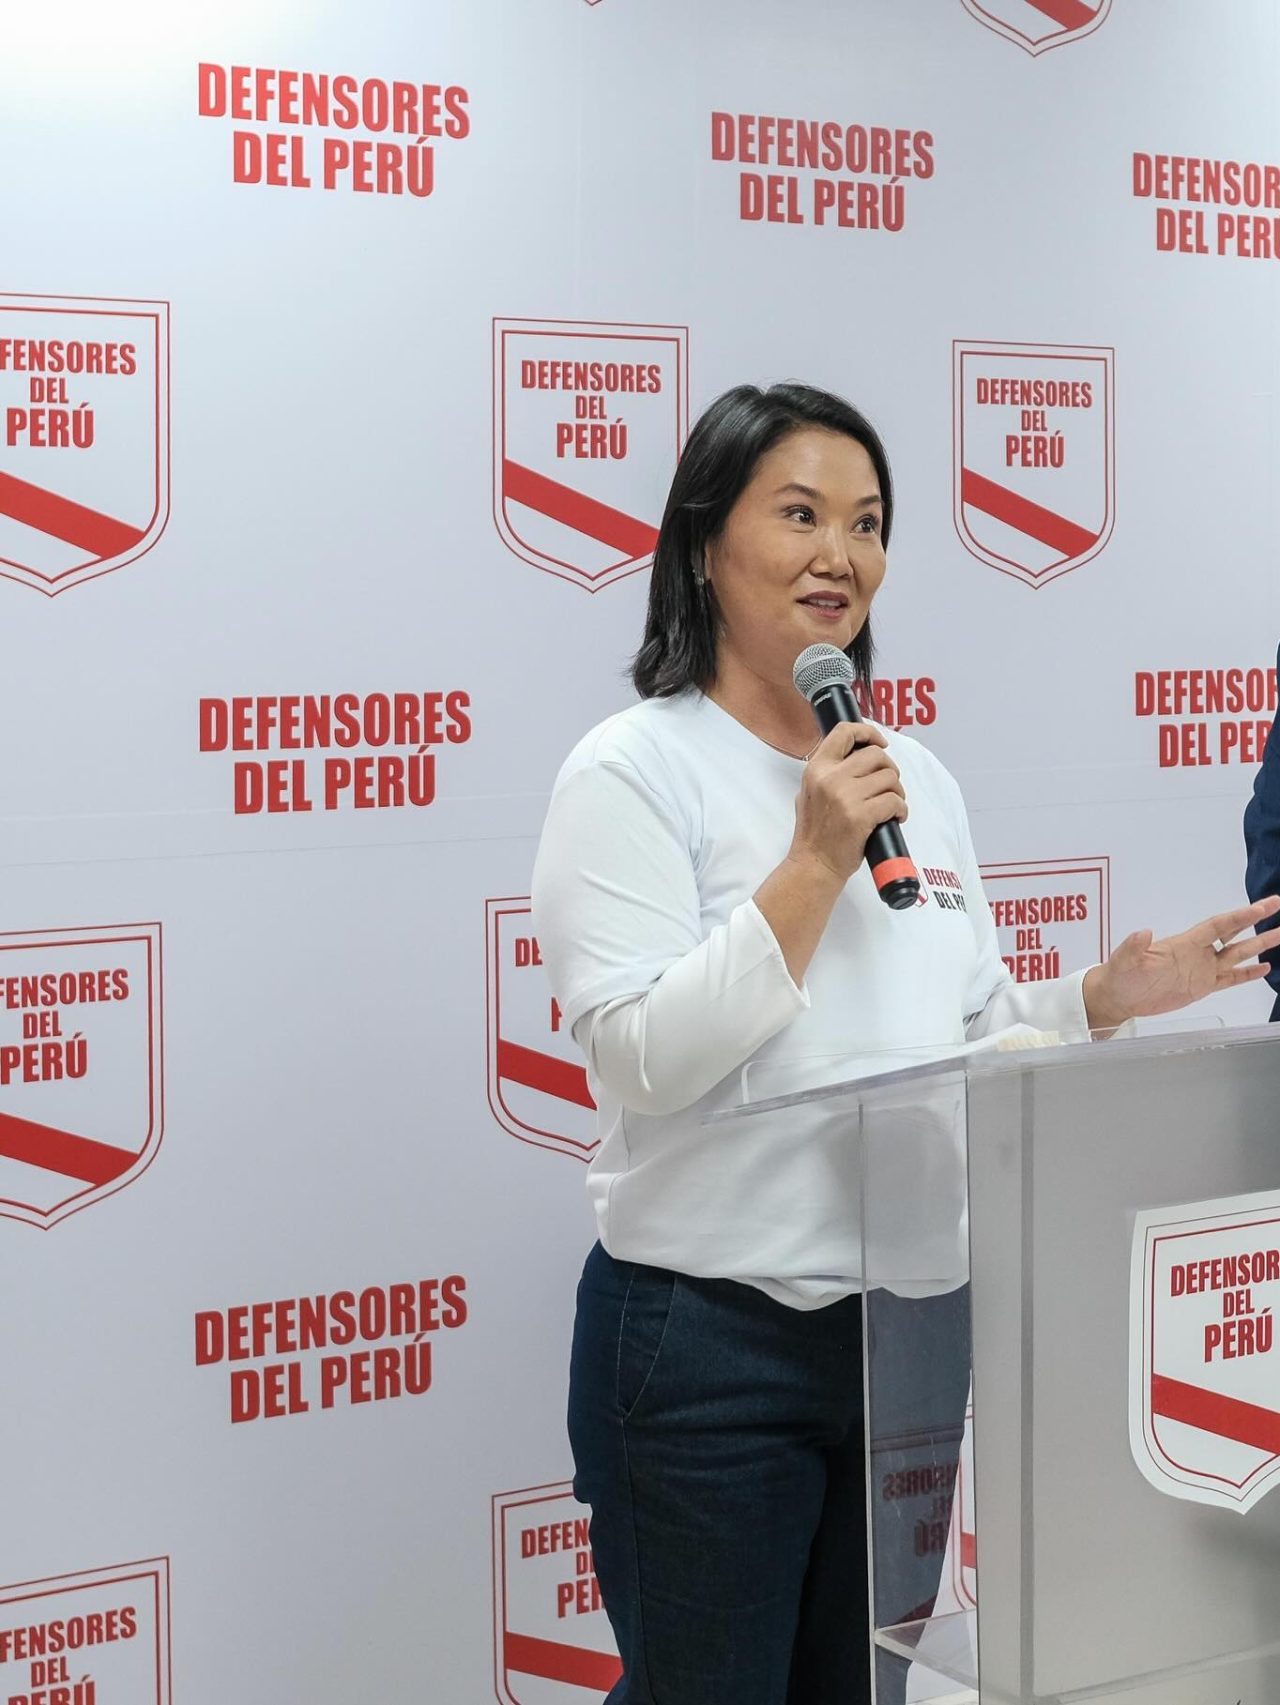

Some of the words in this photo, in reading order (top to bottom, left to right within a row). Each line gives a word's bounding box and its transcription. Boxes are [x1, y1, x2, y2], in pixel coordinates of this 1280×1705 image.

[199, 63, 469, 140] DEFENSORES
[234, 131, 311, 188] DEL
[324, 135, 439, 197] PERÚ
[711, 112, 934, 183] DEFENSORES
[740, 172, 803, 224] DEL
[814, 176, 904, 232] PERÚ
[1156, 208, 1209, 254] DEL
[30, 376, 68, 404] DEL
[521, 360, 662, 393] DEFENSORES
[976, 378, 1093, 412] DEFENSORES
[7, 402, 94, 448] PERÚ
[576, 394, 606, 420] DEL
[1020, 408, 1047, 433] DEL
[556, 418, 628, 460] PERÚ
[1006, 434, 1065, 468] PERÚ
[200, 691, 471, 752] DEFENSORES
[1159, 723, 1212, 768] DEL
[235, 760, 312, 815] DEL
[325, 745, 435, 810] PERÚ
[933, 891, 956, 910] DEL
[988, 894, 1087, 927] FENSORES
[1016, 928, 1041, 952] DEL
[0, 969, 128, 1009] ENSORES
[23, 1010, 61, 1039] DEL
[0, 1032, 87, 1085] PERÚ
[195, 1276, 467, 1365] DEFENSORES
[1222, 1288, 1255, 1319] DEL
[1204, 1309, 1273, 1362] PERÚ
[231, 1362, 309, 1423] DEL
[321, 1332, 432, 1408] PERÚ
[31, 1656, 70, 1687] DEL
